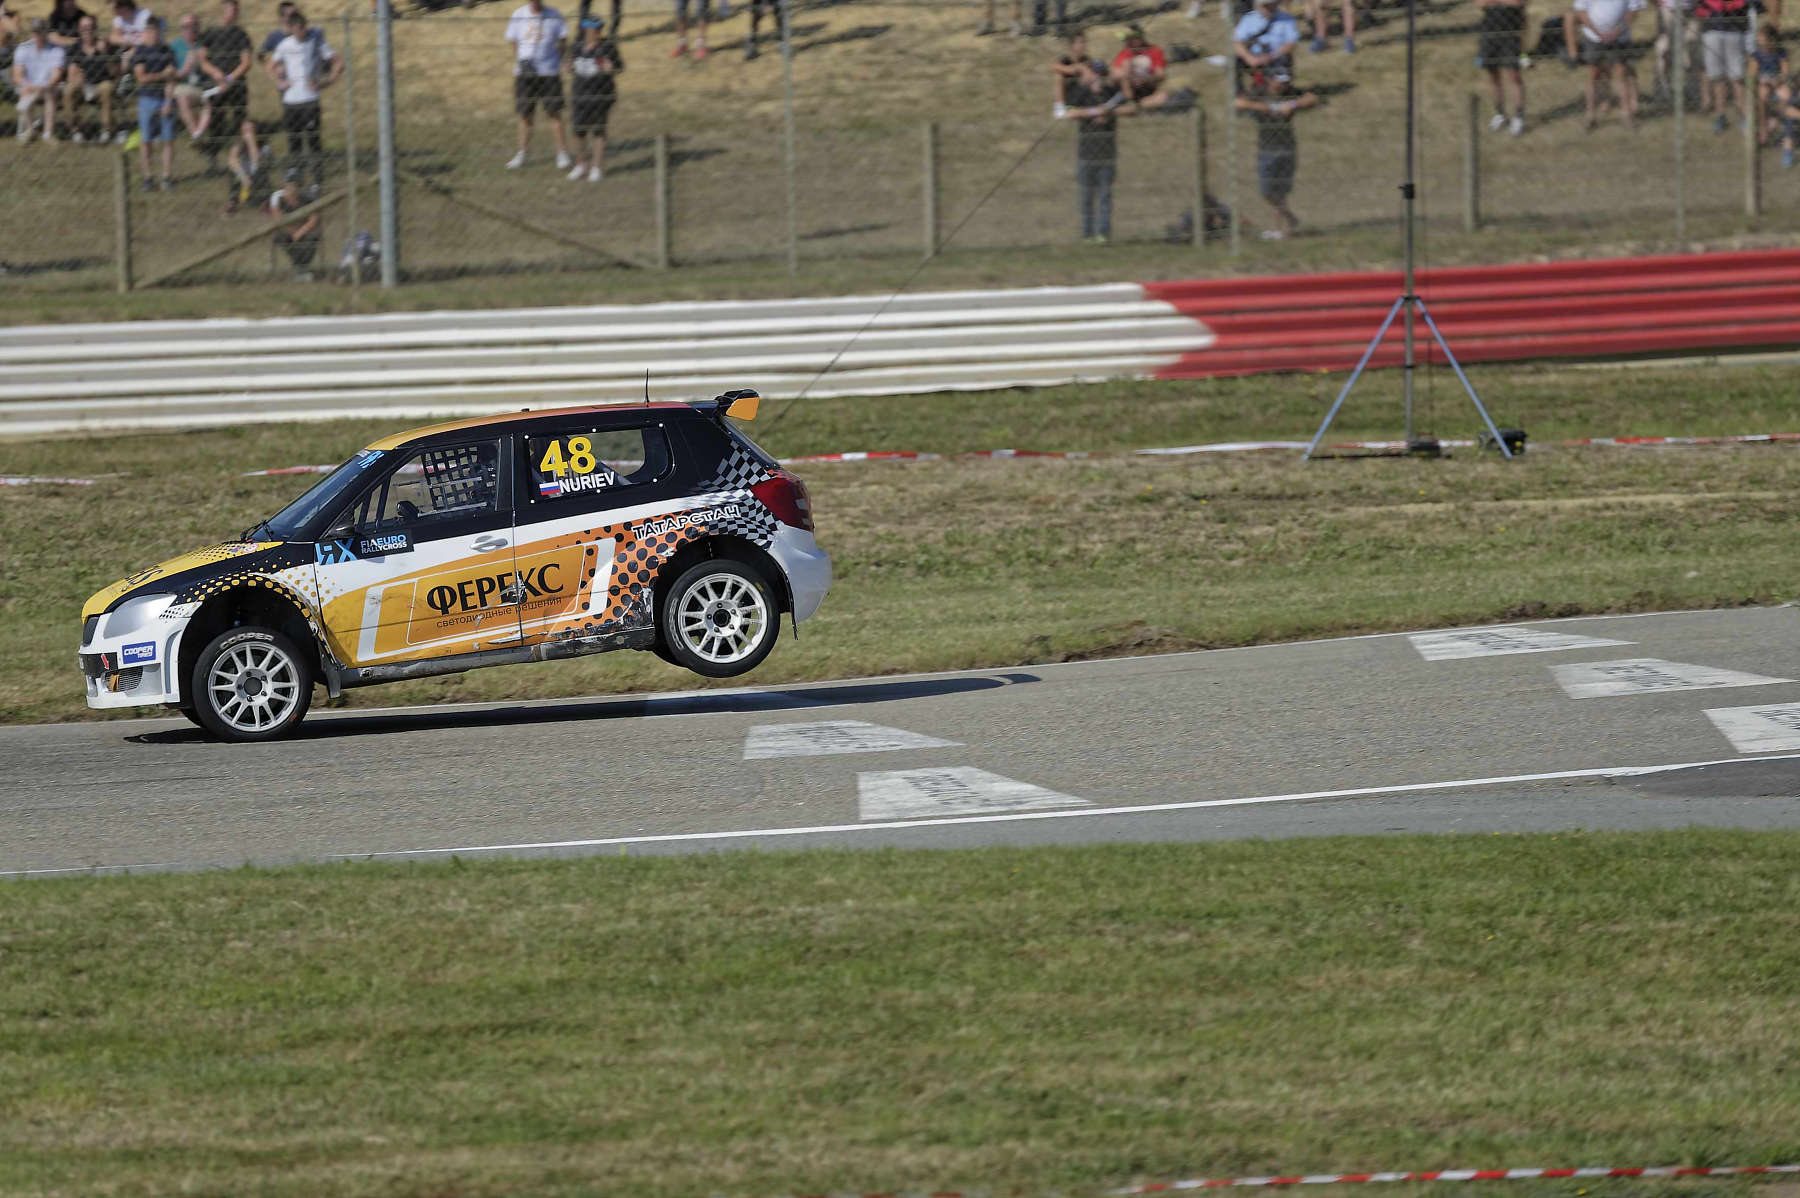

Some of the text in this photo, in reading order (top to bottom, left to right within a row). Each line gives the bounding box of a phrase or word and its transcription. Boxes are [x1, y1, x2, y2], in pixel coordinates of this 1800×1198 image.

[540, 436, 596, 477] 48
[559, 471, 615, 494] NURIEV
[631, 504, 741, 541] ТАТАРСТАН
[361, 541, 408, 554] RALLYCROSS
[426, 563, 564, 616] ФЕРЕКС
[123, 645, 154, 656] COOPER
[220, 632, 275, 649] COOPER
